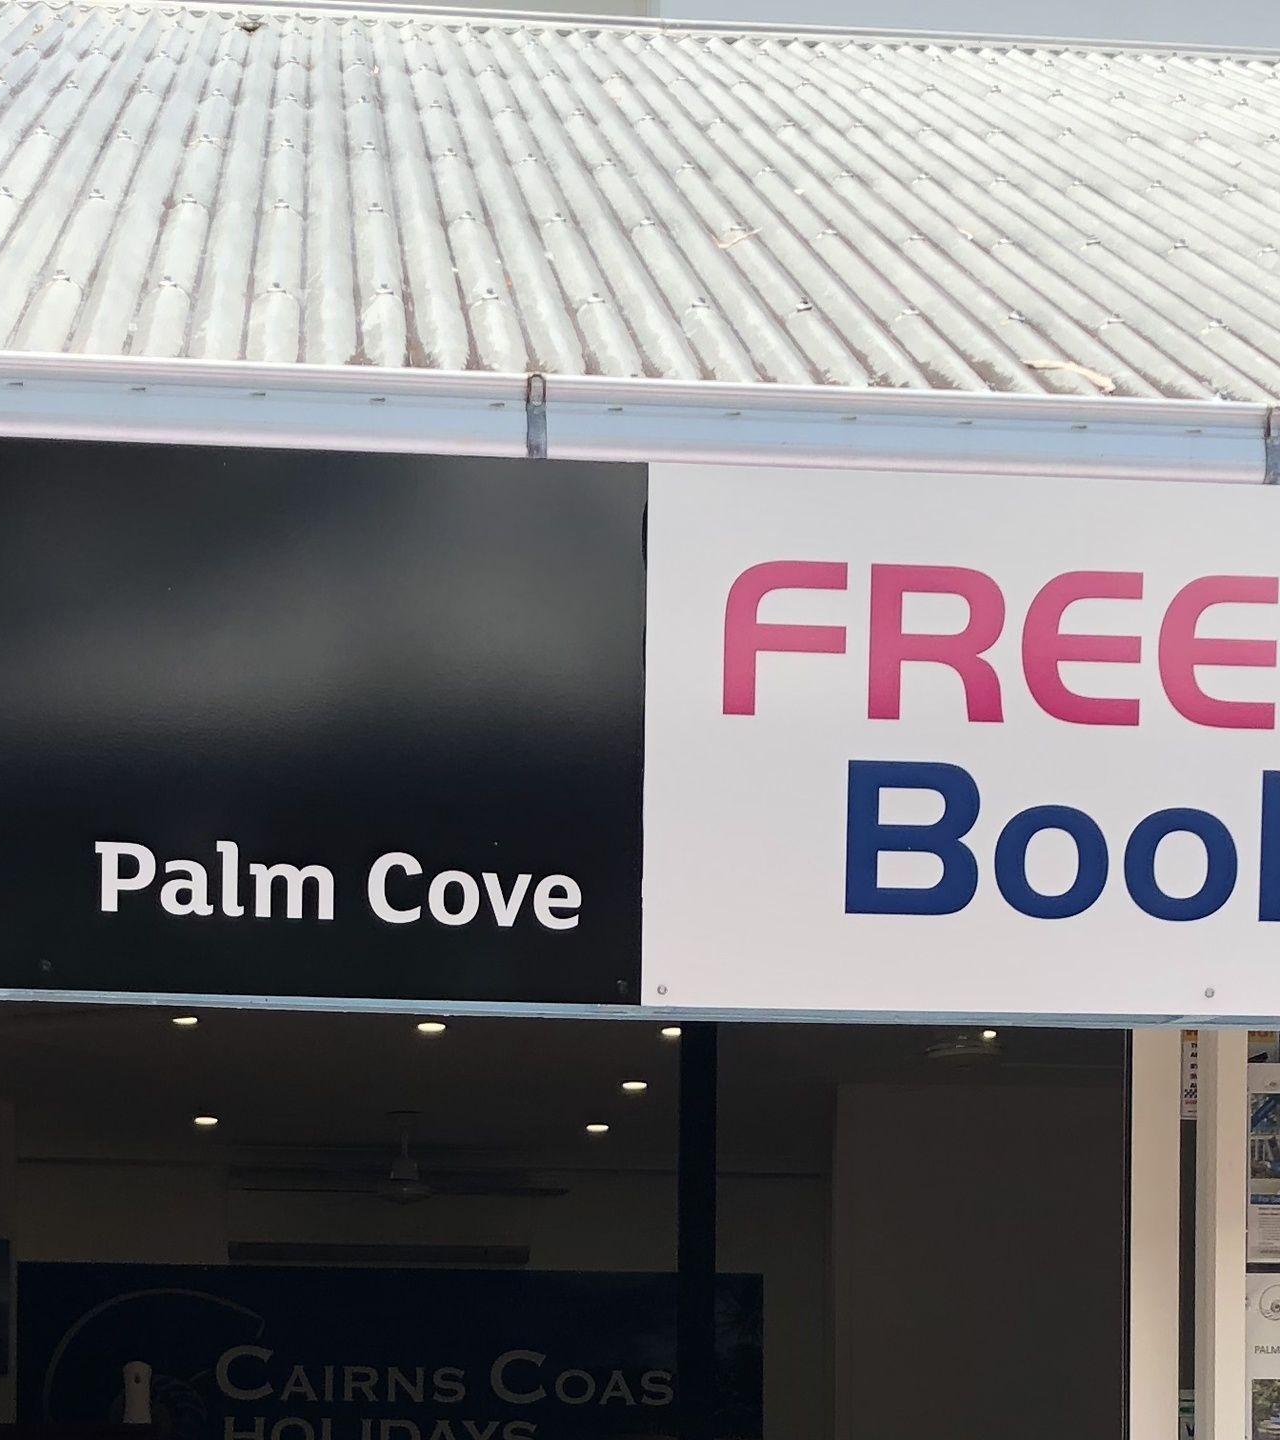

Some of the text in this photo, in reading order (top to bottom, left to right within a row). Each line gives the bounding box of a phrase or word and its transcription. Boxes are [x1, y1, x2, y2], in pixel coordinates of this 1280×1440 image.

[723, 560, 1280, 731] FREE
[95, 841, 582, 930] Palm Cove
[215, 1344, 675, 1407] CAIRNS COAS
[1254, 1345, 1280, 1355] PALM
